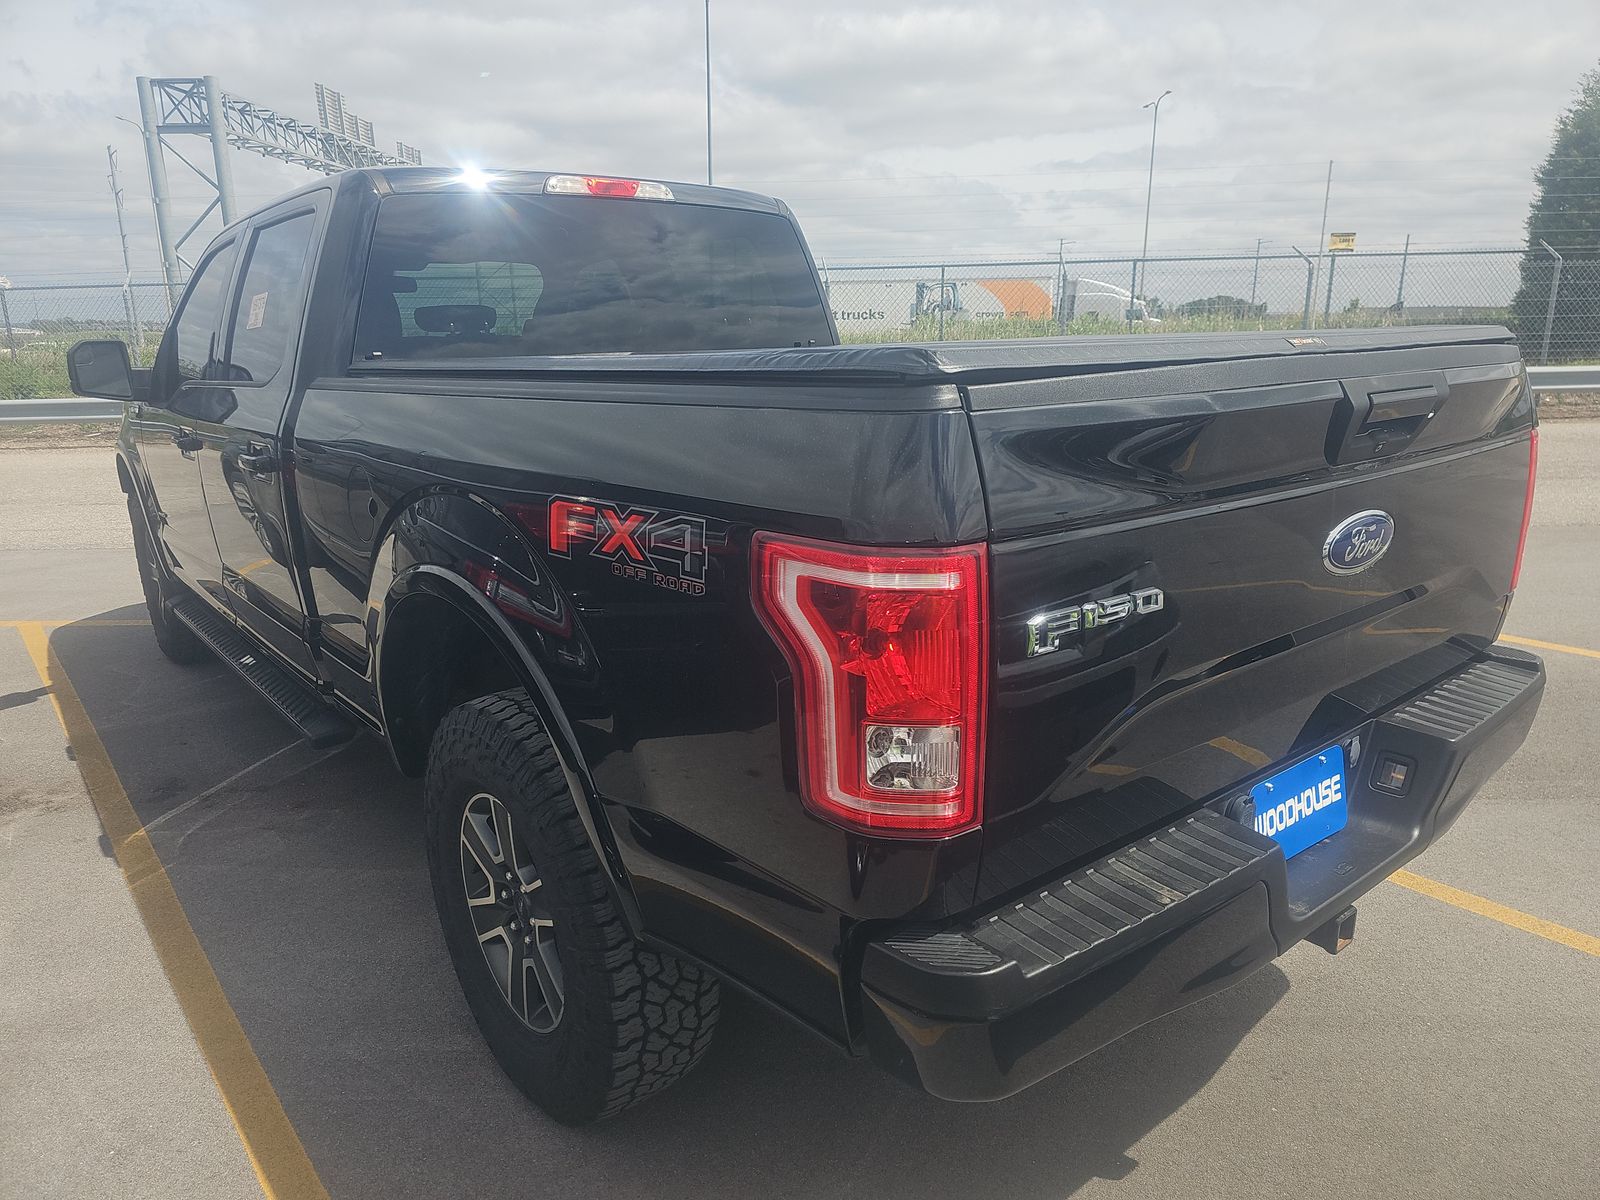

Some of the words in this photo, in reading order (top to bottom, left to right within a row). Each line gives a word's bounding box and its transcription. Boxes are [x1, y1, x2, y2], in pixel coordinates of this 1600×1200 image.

[841, 308, 885, 321] trucks
[548, 494, 708, 583] FX4
[1344, 523, 1385, 562] Ford
[612, 563, 647, 581] OFF
[653, 572, 705, 596] ROAD
[1027, 586, 1164, 658] F150
[1254, 774, 1342, 837] WOODHOUSE
